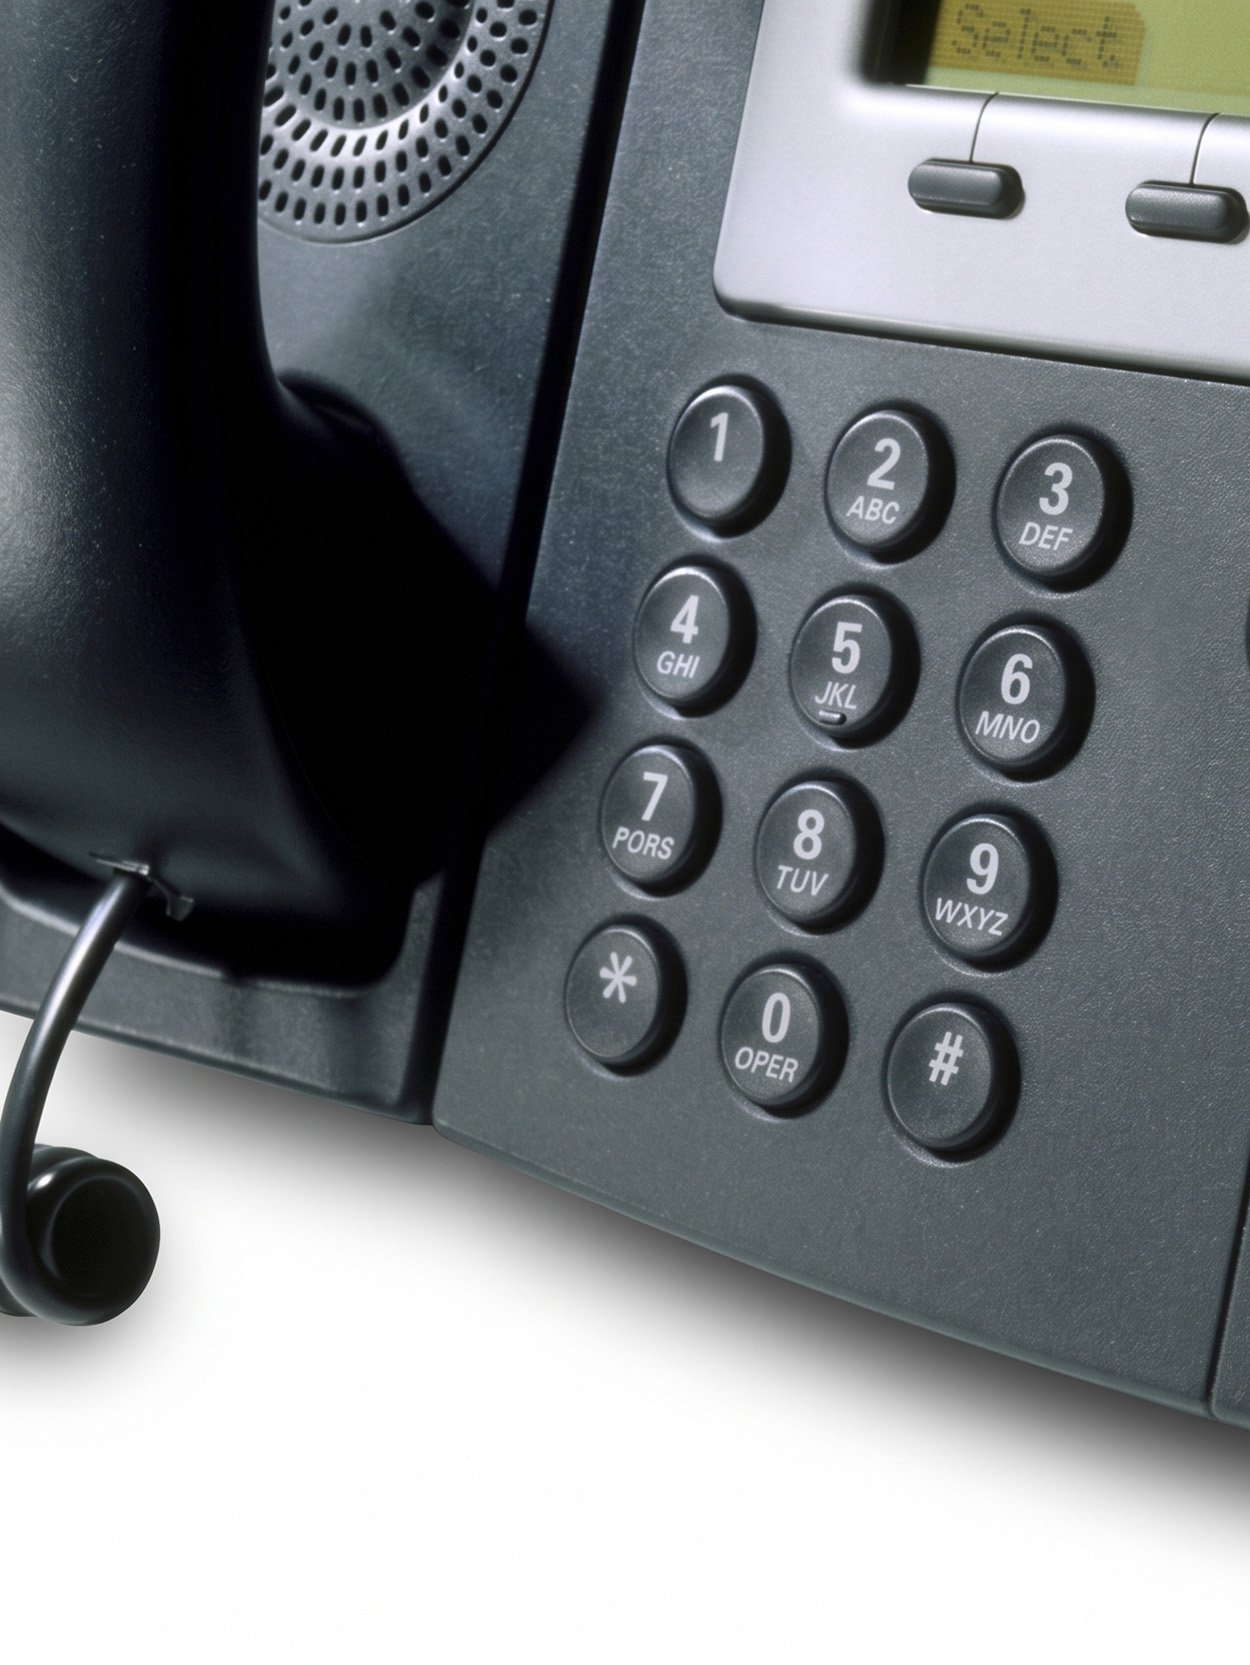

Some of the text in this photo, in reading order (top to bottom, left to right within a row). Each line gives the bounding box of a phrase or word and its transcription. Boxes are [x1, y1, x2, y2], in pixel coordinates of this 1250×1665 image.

[951, 4, 1119, 69] Select
[709, 412, 730, 462] 1
[867, 438, 901, 491] 2
[1039, 463, 1074, 515] 3
[847, 495, 900, 524] ABC
[1019, 522, 1073, 550] DEF
[670, 595, 700, 643] 4
[656, 650, 700, 679] GHI
[831, 622, 861, 674] 5
[815, 682, 858, 710] JKL
[1000, 653, 1034, 705] 6
[975, 710, 1040, 743] MNO
[640, 772, 668, 822] 7
[792, 809, 825, 861] 8
[776, 865, 828, 896] TUV
[966, 843, 999, 895] 9
[935, 898, 1008, 936] WXYZ
[761, 992, 791, 1044] 0
[734, 1046, 799, 1083] OPER
[928, 1031, 963, 1086] #
